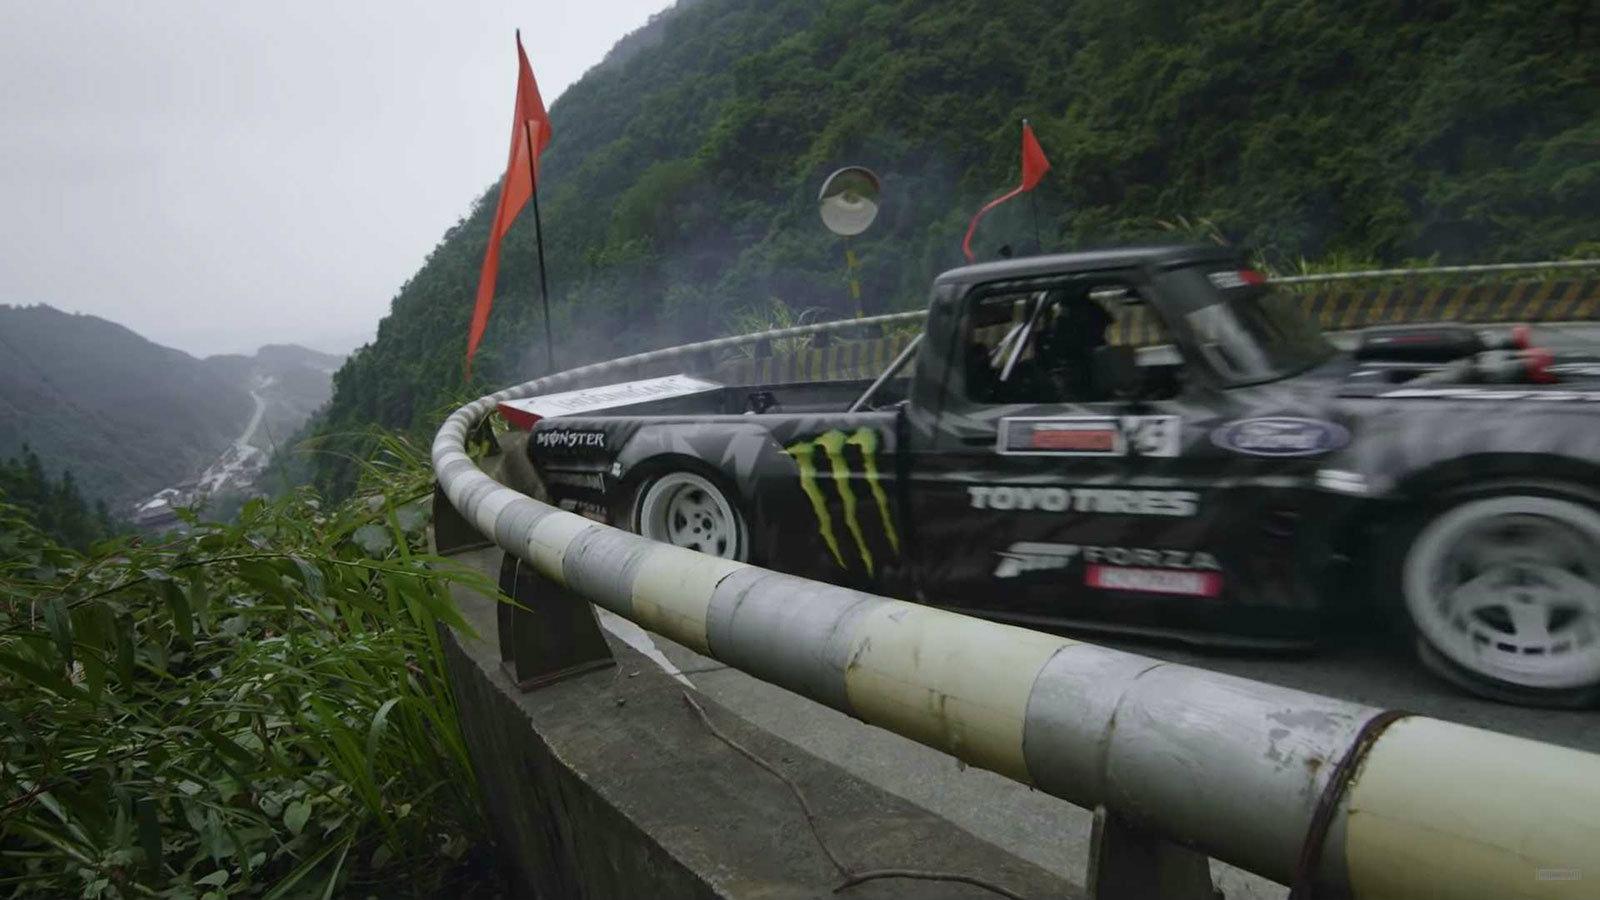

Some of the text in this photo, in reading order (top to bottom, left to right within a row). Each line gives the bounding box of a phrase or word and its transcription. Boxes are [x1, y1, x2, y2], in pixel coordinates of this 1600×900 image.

[967, 486, 1200, 516] TOYO TIRES
[1083, 544, 1220, 570] FORZA
